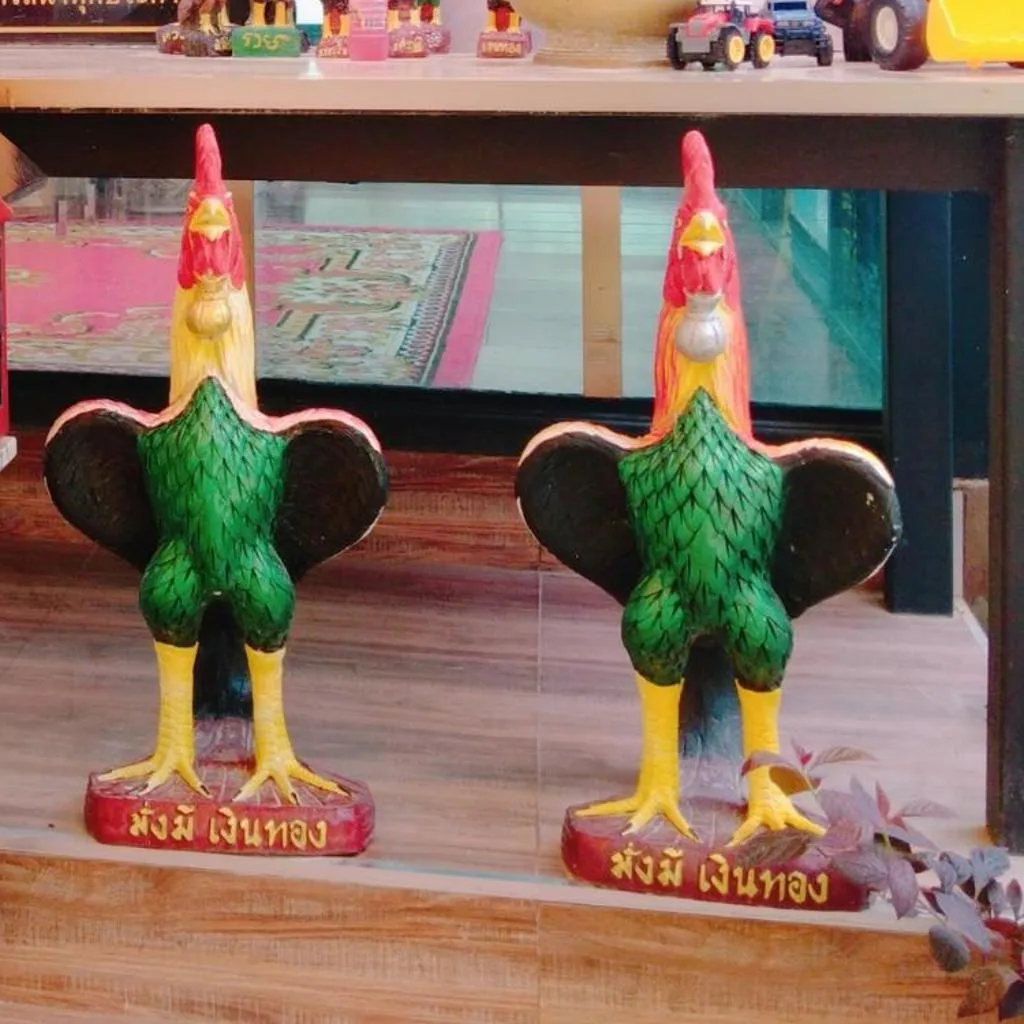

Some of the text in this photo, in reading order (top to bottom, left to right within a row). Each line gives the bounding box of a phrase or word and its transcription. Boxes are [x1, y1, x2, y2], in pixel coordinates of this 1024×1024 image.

[208, 806, 328, 850] เงินทอง
[697, 852, 830, 904] เงินทอง
